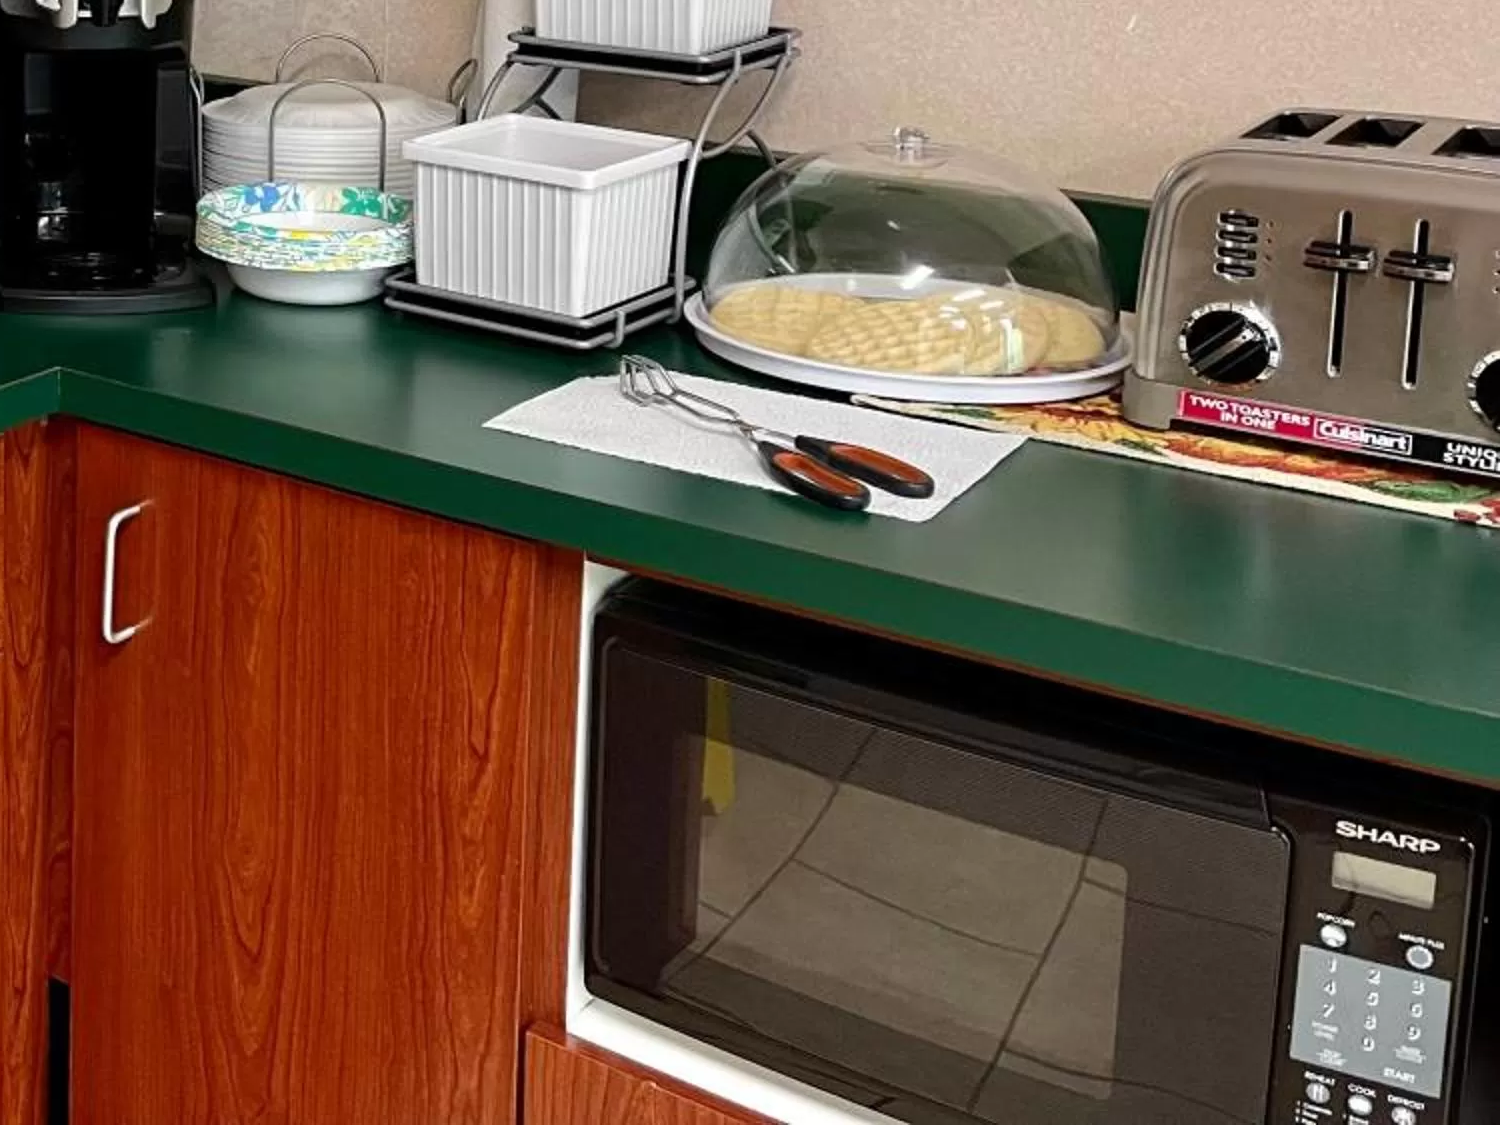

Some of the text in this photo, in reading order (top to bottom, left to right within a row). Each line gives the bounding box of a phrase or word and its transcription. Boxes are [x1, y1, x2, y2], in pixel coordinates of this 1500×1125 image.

[1189, 394, 1311, 426] TWO TOASTERS
[1220, 411, 1276, 431] IN ONE
[1319, 420, 1407, 451] Cuisinart
[1446, 442, 1500, 459] UNIQ
[1335, 820, 1440, 854] SHARP
[1368, 968, 1381, 985] 2
[1323, 1004, 1335, 1018] 7
